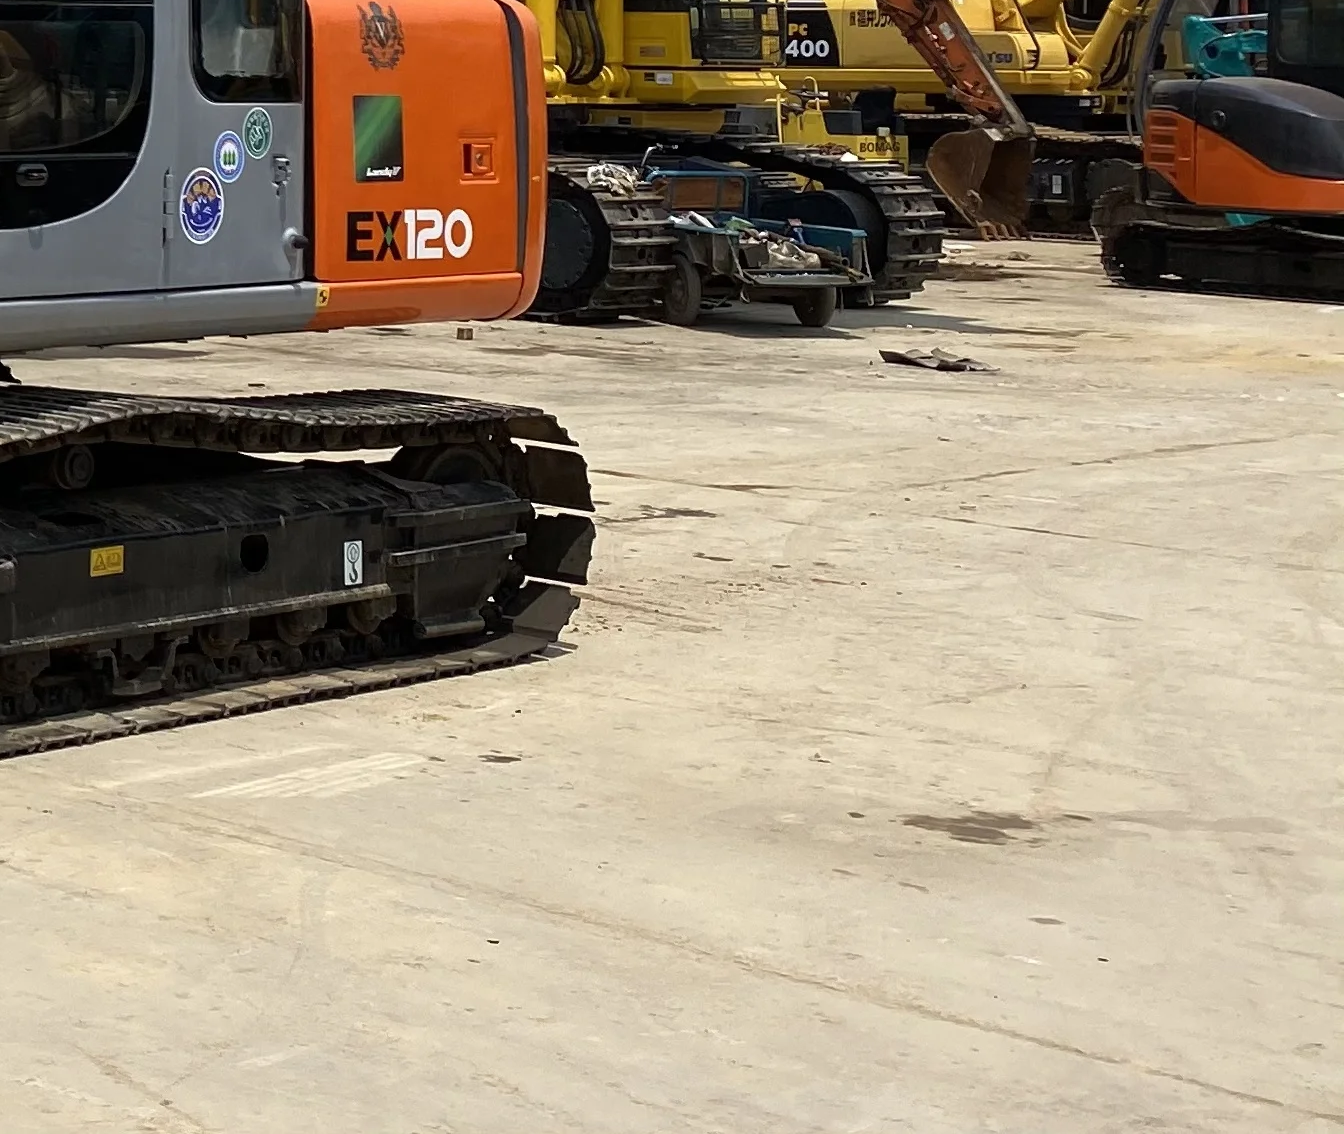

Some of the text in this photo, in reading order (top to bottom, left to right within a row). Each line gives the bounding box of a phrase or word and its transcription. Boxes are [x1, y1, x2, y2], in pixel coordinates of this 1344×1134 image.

[788, 23, 808, 36] PC
[785, 39, 830, 58] 400
[346, 208, 473, 262] EX120
